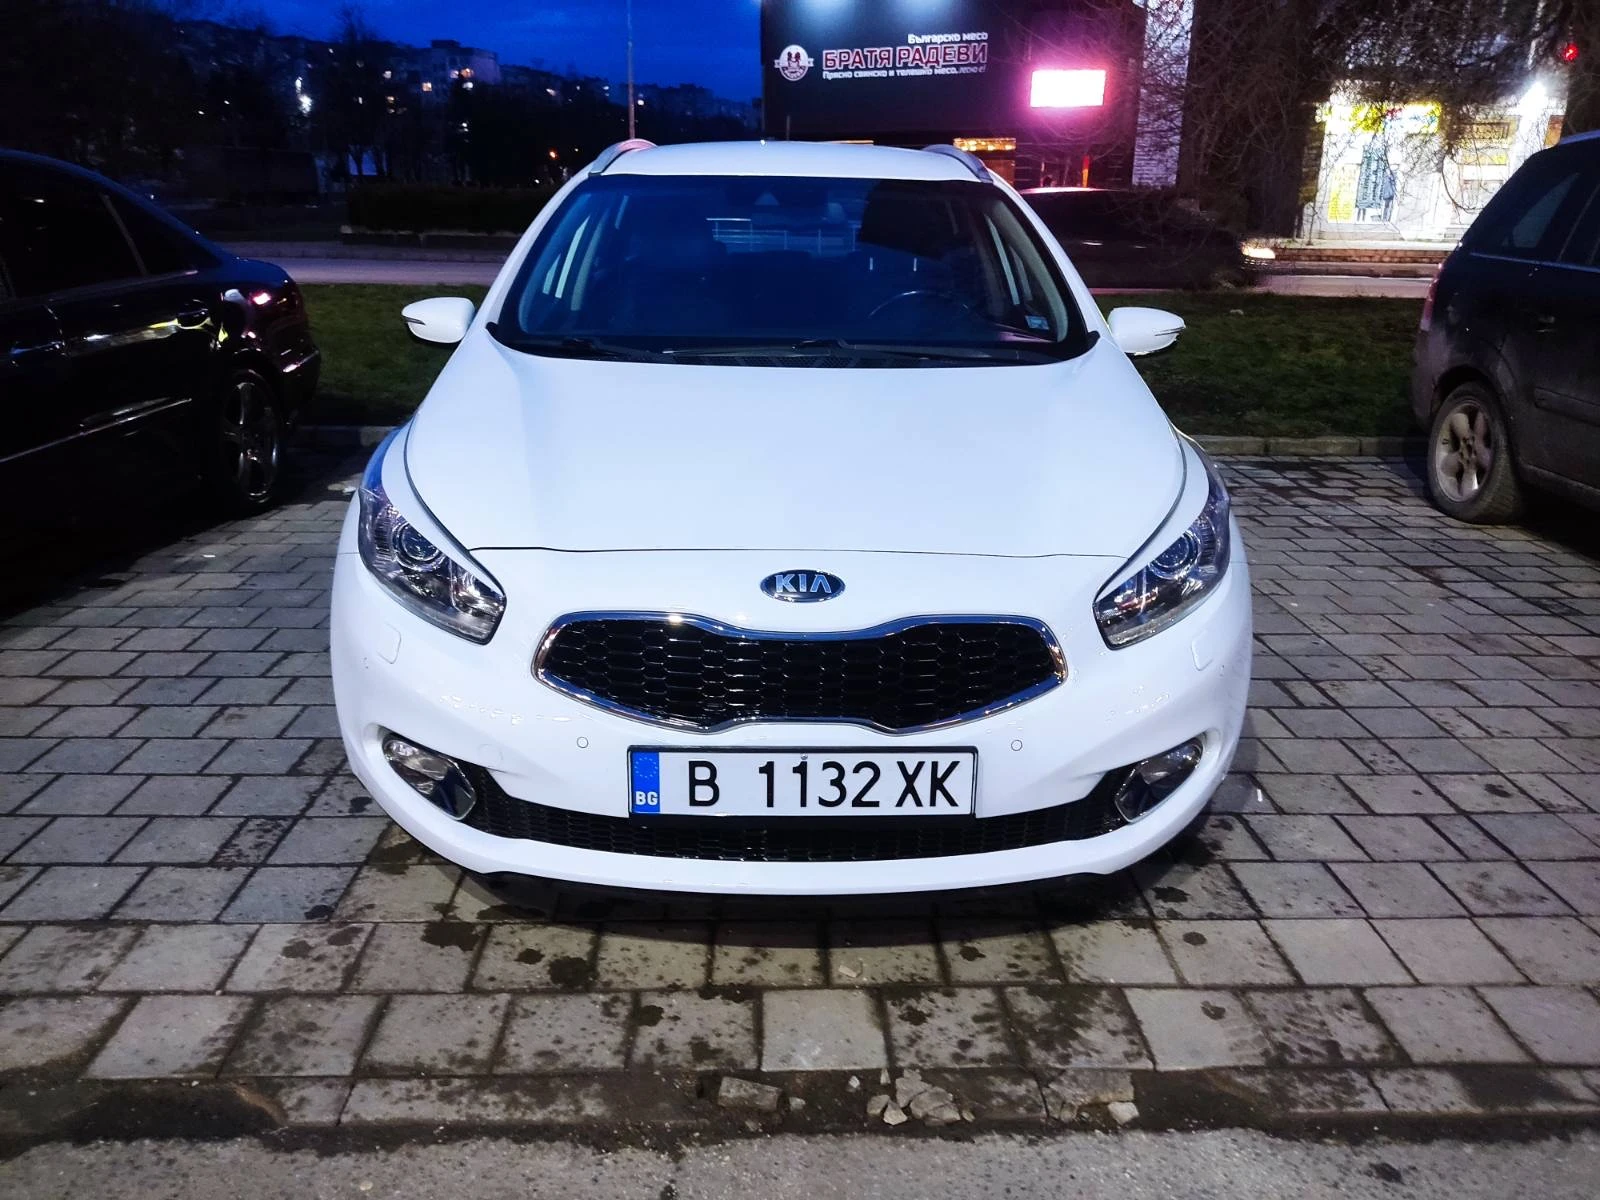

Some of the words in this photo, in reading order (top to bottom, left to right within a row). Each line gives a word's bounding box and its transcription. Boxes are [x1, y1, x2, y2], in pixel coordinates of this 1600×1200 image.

[907, 33, 960, 44] Българско
[962, 32, 988, 41] месо
[822, 47, 892, 70] БРАТЯ
[896, 43, 988, 68] РАДЕВИ
[774, 573, 832, 593] KIA
[688, 760, 720, 807] B
[758, 760, 881, 807] 1132
[895, 760, 960, 807] XK
[635, 790, 659, 806] BG
